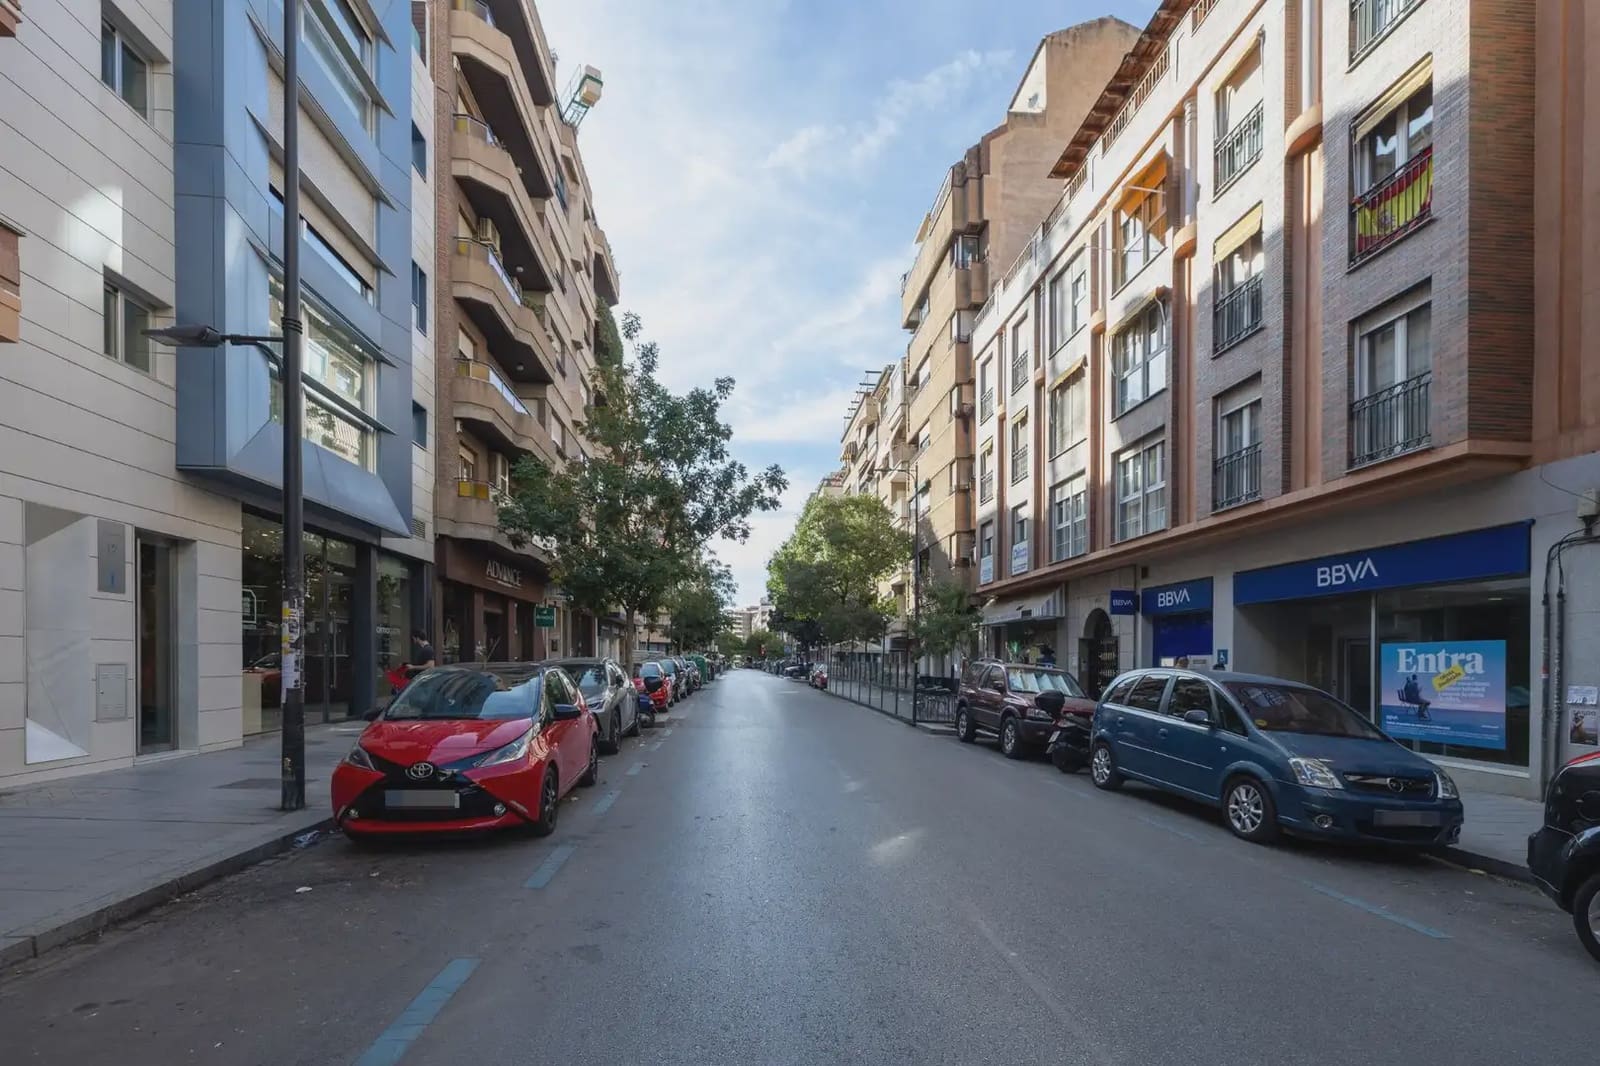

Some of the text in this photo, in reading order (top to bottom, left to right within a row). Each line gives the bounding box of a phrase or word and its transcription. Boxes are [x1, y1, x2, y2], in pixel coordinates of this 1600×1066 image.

[486, 559, 522, 587] ADVANCE
[1317, 557, 1378, 588] BBVA
[1112, 599, 1133, 607] BBVA
[1157, 587, 1190, 608] BBVA
[1397, 648, 1485, 674] Entra
